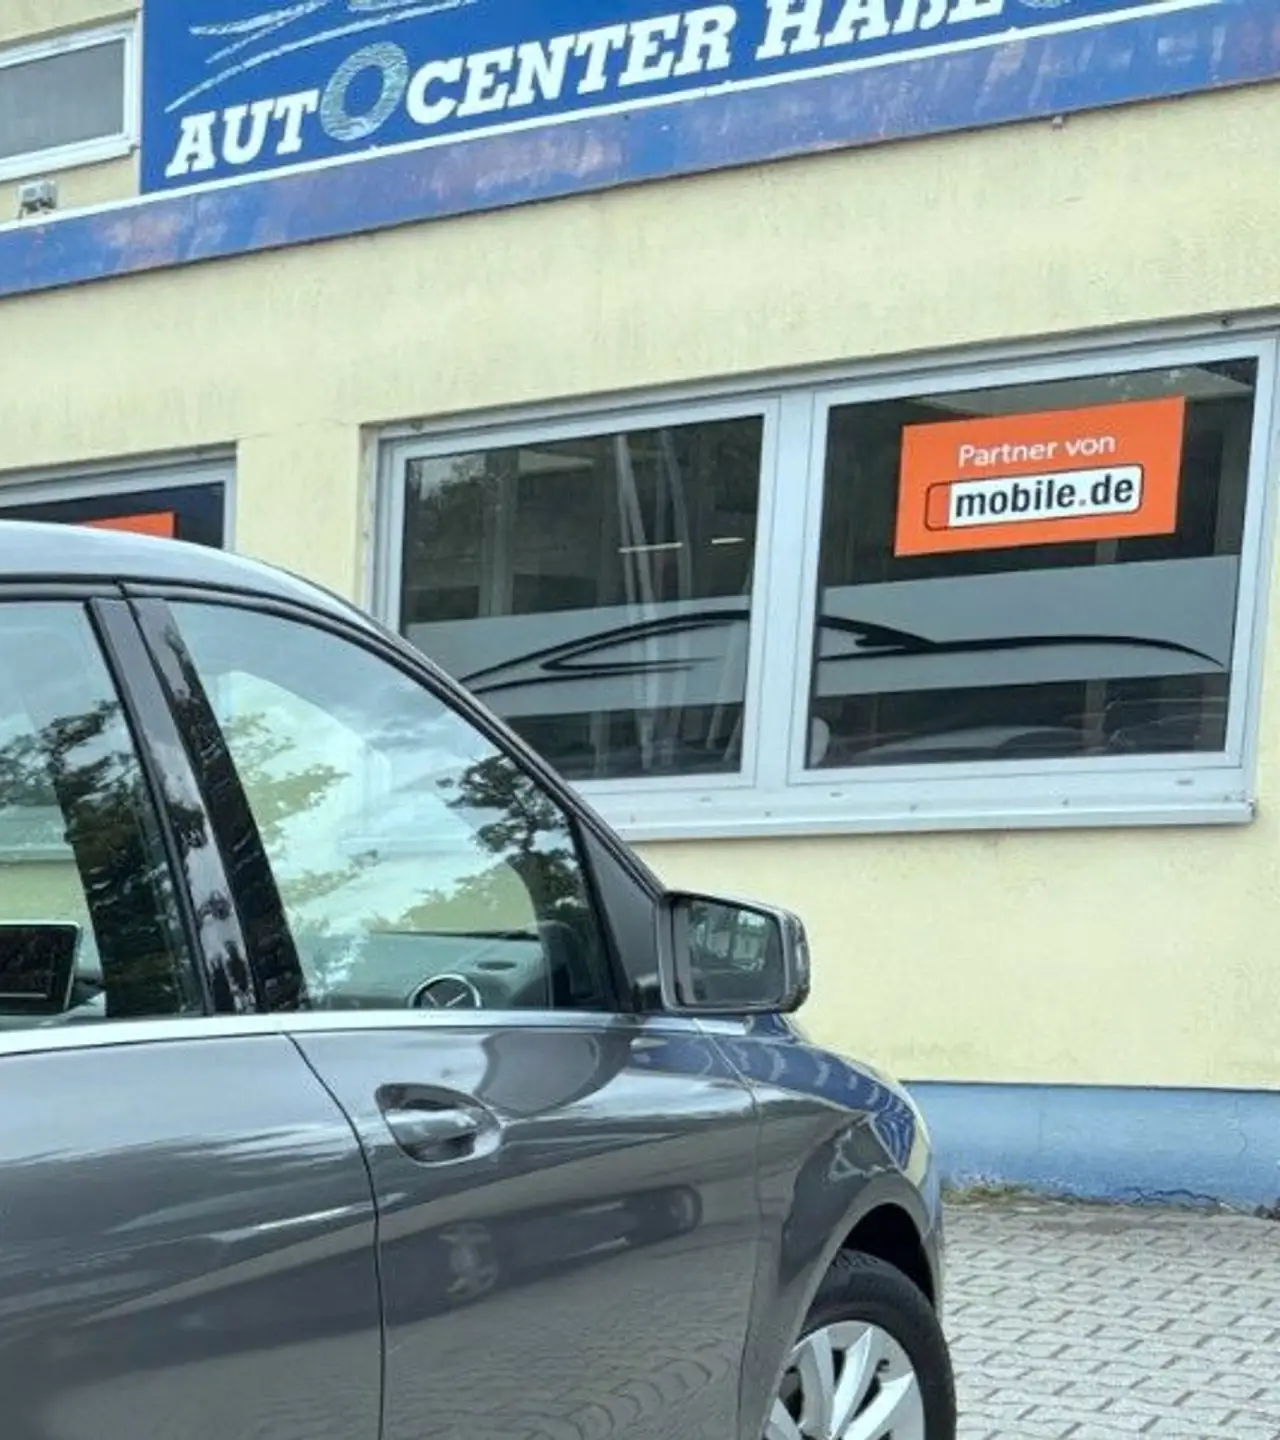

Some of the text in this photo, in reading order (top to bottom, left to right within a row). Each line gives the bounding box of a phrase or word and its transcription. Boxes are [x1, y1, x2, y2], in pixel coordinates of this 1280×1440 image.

[957, 435, 1116, 468] Partner von
[955, 473, 1135, 518] mobile.de
